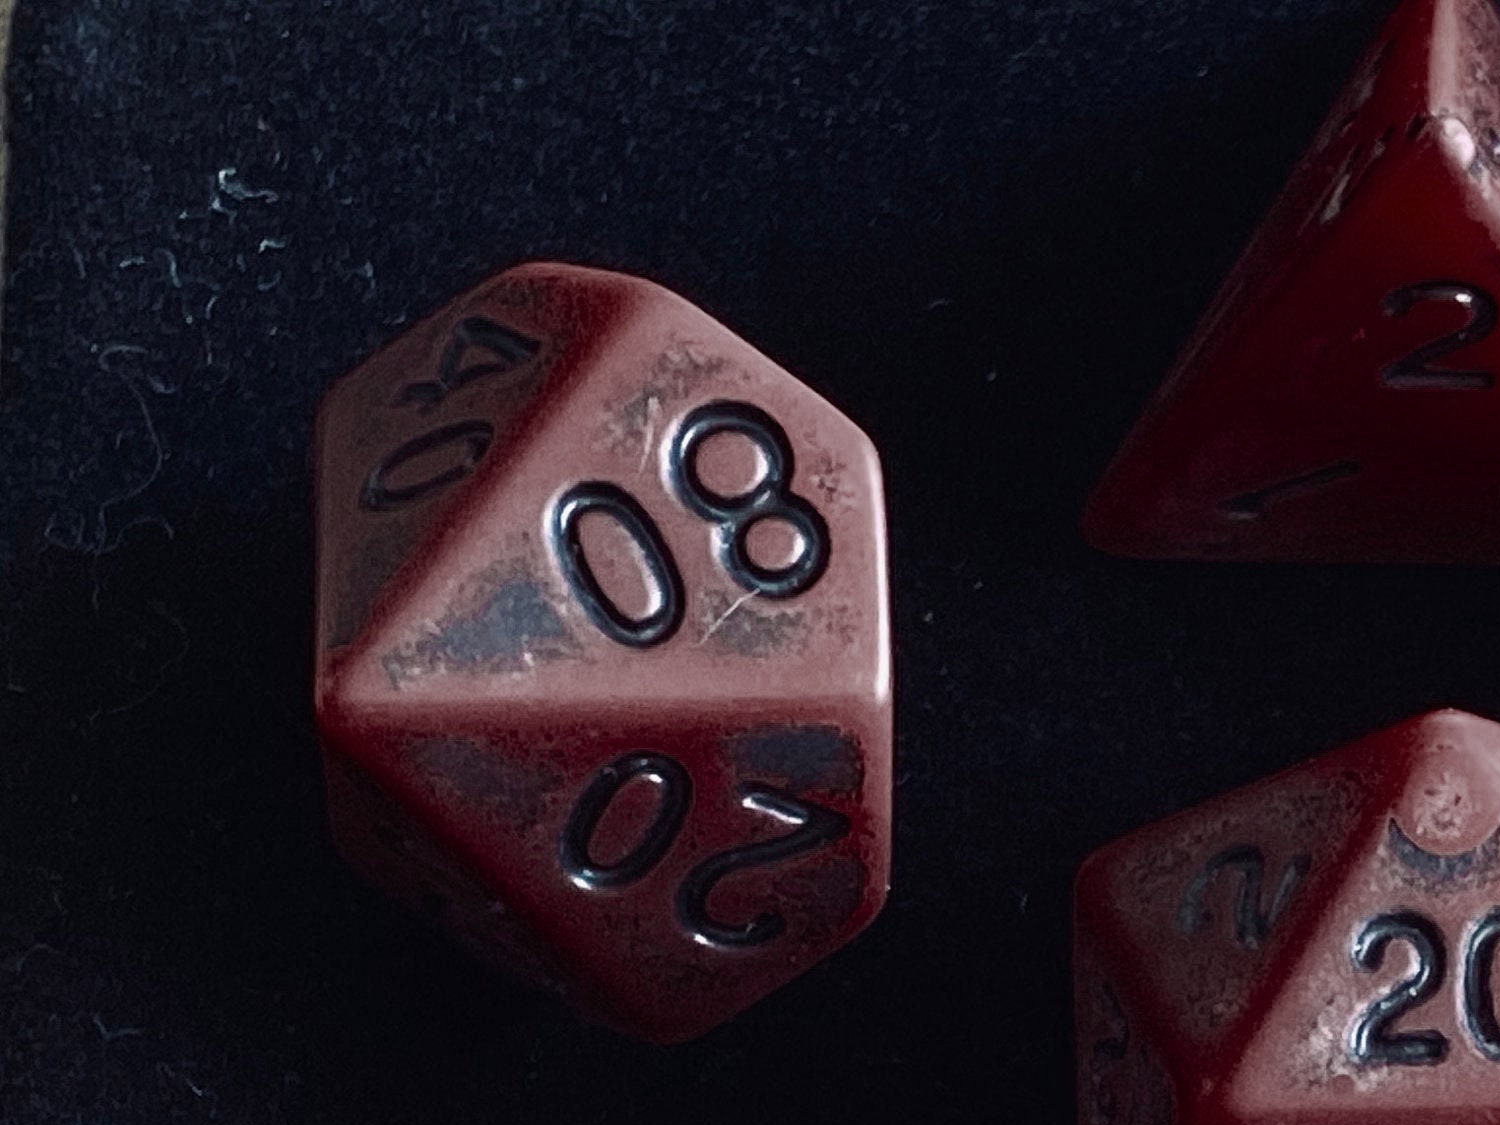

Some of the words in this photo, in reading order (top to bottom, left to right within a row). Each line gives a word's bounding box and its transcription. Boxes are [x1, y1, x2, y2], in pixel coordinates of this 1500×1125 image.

[1377, 279, 1499, 391] 2
[544, 399, 832, 649] 80
[560, 749, 853, 952] 20
